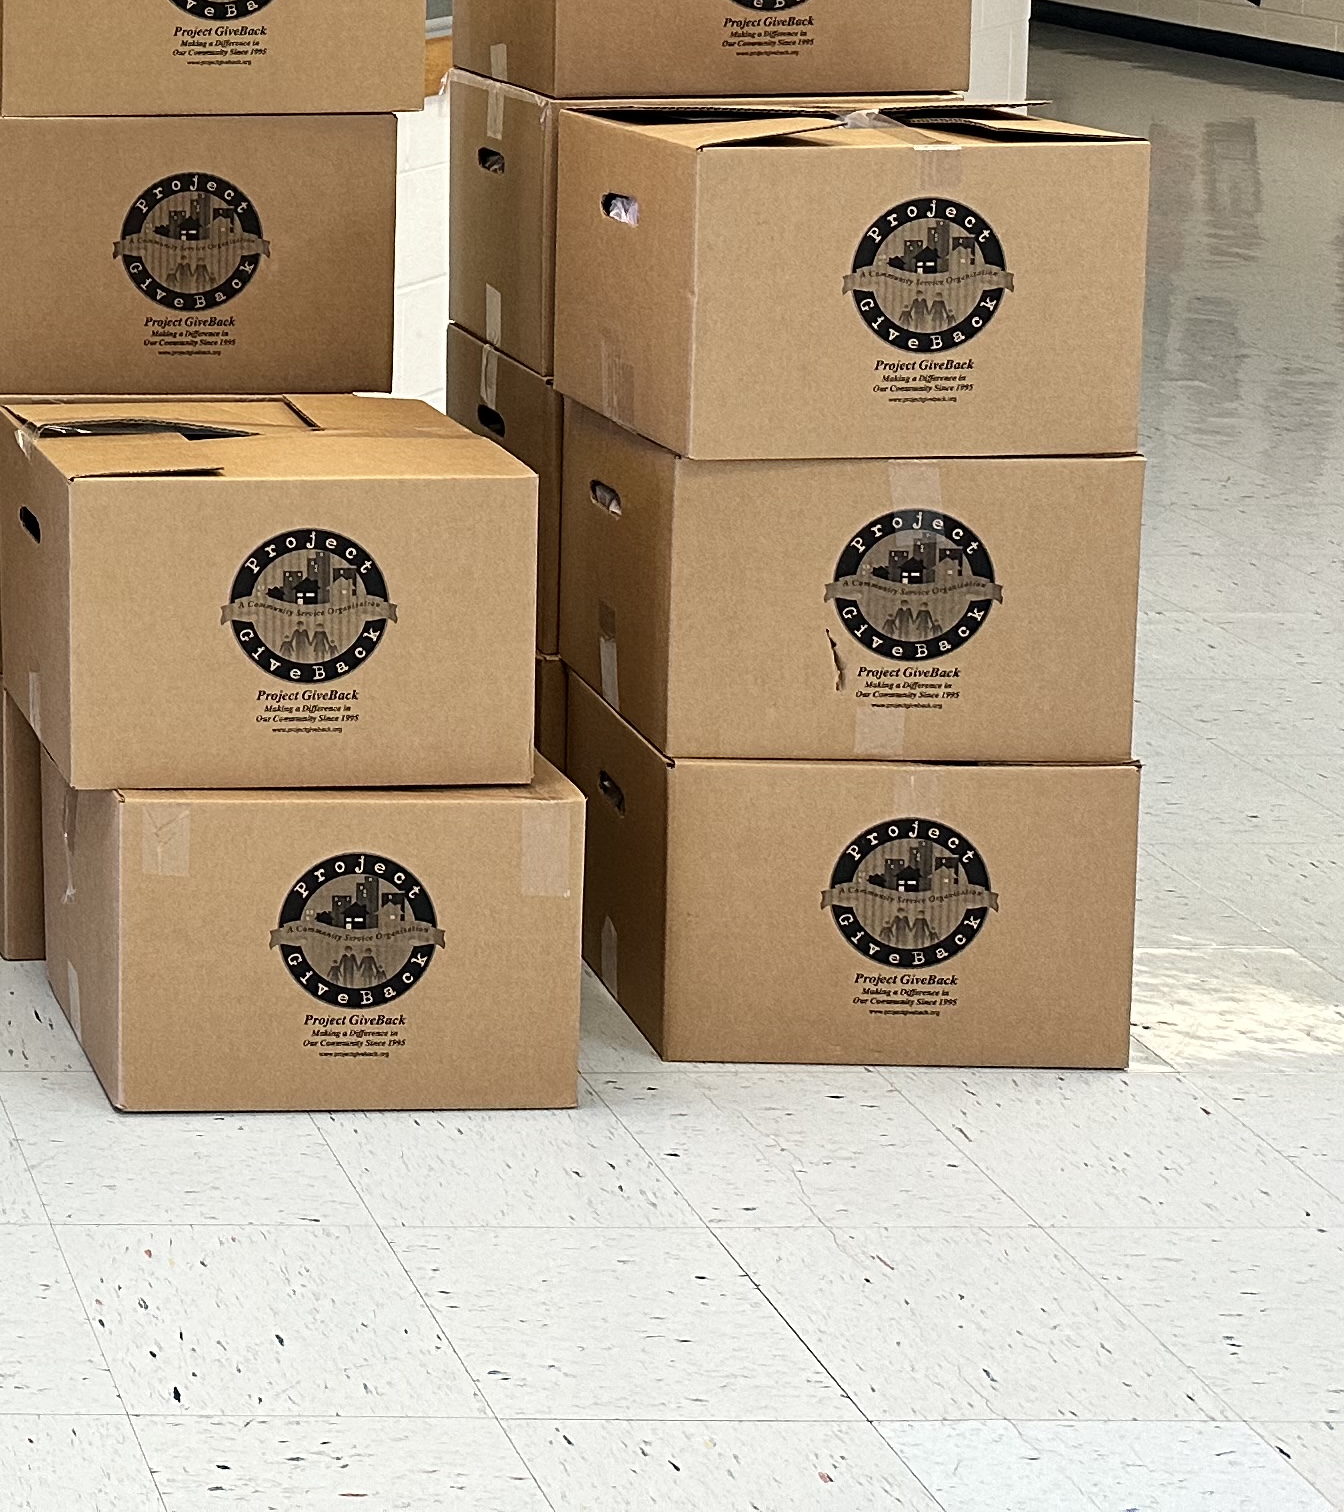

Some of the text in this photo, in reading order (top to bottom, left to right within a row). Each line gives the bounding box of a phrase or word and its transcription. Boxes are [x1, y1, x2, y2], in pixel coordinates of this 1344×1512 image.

[172, 25, 267, 39] Project GiveBack
[135, 174, 249, 214] Project
[867, 199, 992, 244] Project
[129, 261, 255, 308] GiveBack
[143, 316, 235, 329] Project GiveBack
[860, 297, 998, 350] GiveBack
[874, 358, 974, 373] Project GiveBack
[245, 530, 374, 574] Project
[850, 511, 981, 555] Project
[842, 606, 986, 657] GiveBack
[239, 627, 381, 680] GiveBack
[856, 666, 961, 680] Project GiveBack
[255, 689, 359, 703] Project GiveBack
[263, 705, 293, 714] Making
[301, 705, 341, 714] Difference
[254, 714, 359, 724] Our Community Since 1995
[846, 820, 976, 863] Project
[294, 855, 422, 899] Project
[839, 914, 982, 965] GiveBack
[287, 953, 429, 1005] GiveBack
[853, 973, 958, 987] Project GiveBack
[303, 1014, 406, 1028] Project GiveBack
